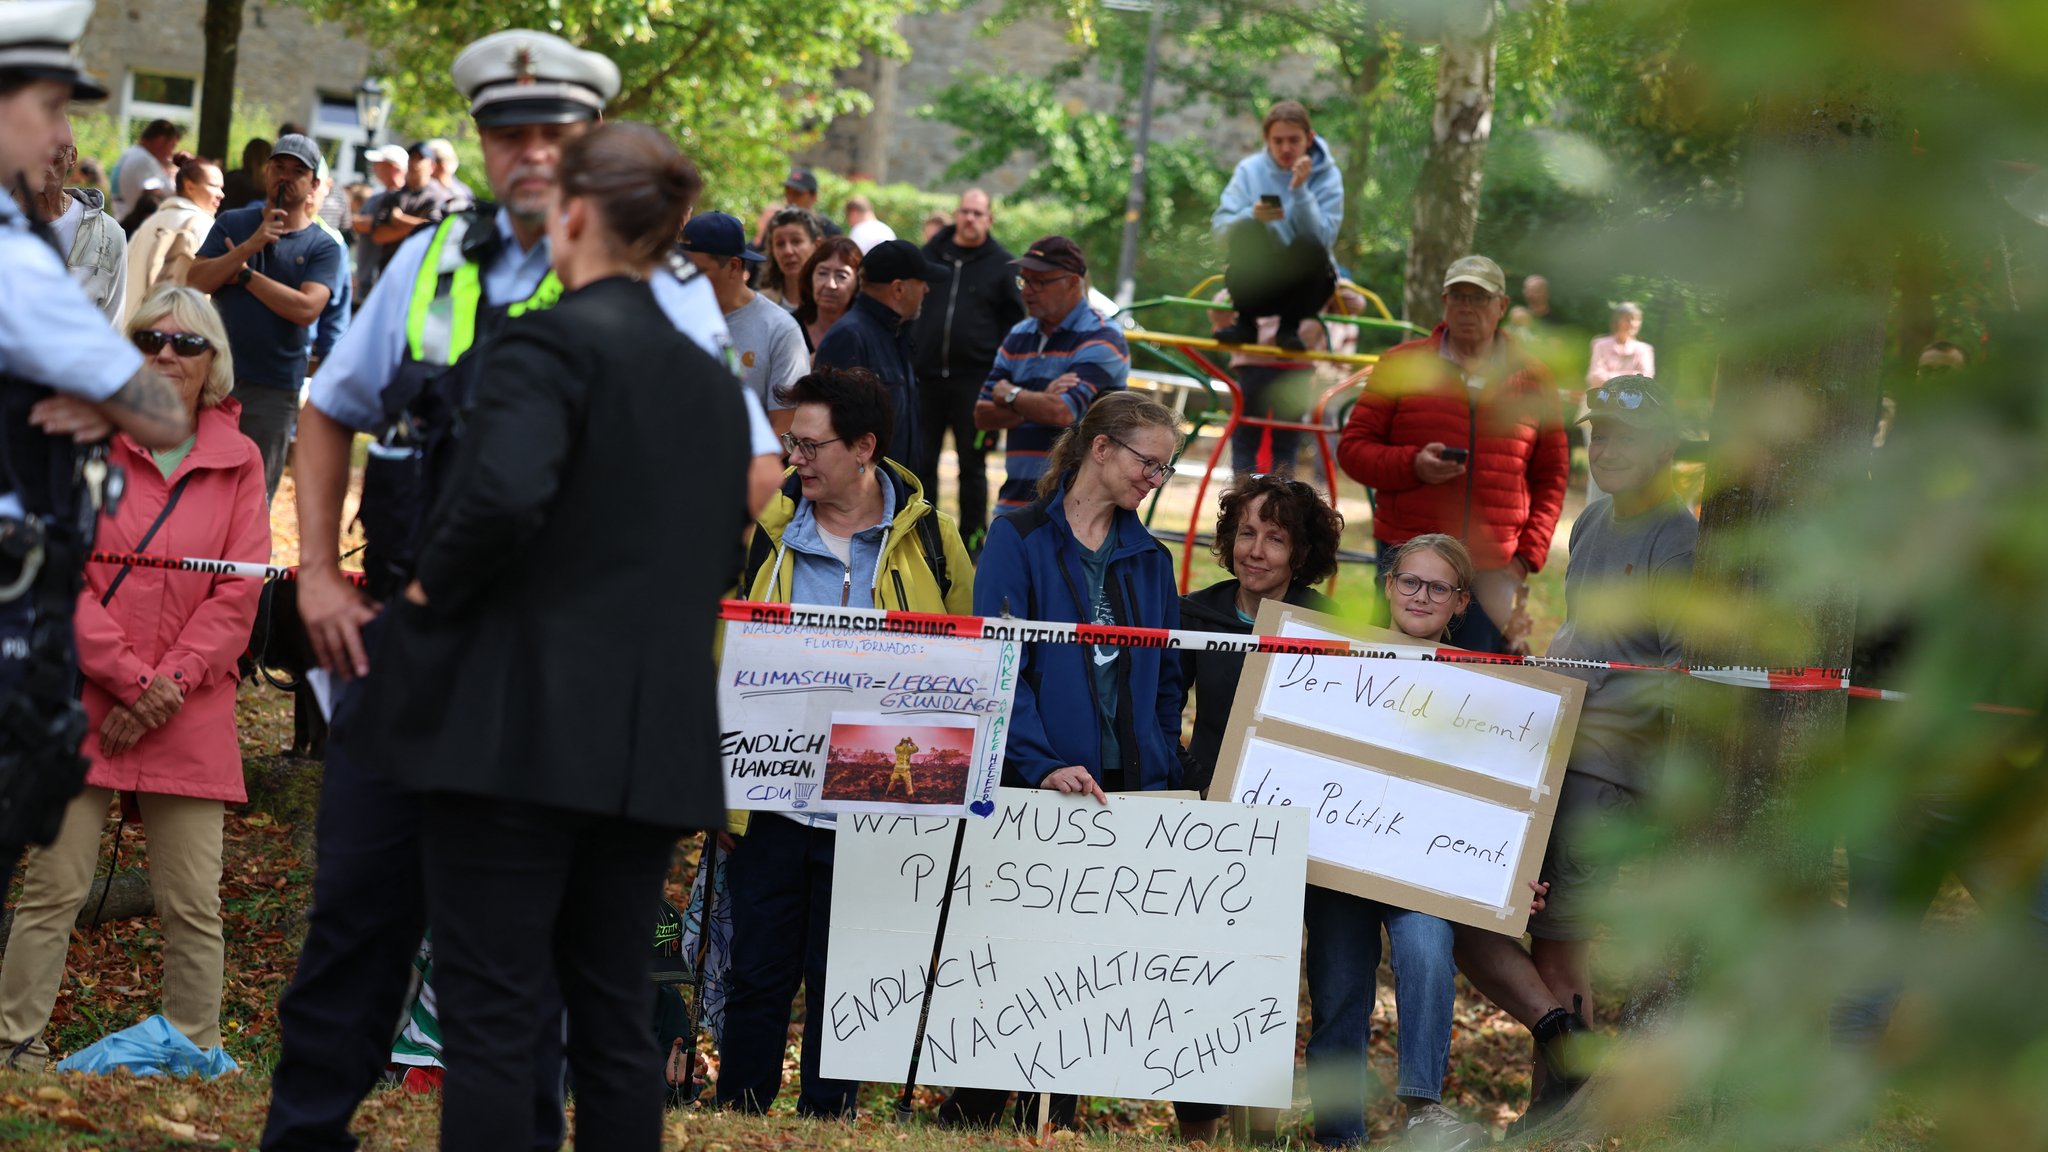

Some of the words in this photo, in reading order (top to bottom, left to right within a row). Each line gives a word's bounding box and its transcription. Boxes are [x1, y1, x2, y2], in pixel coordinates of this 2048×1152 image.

[879, 693, 999, 713] GRUNDLAGE
[1001, 642, 1015, 691] ANKE
[1279, 654, 1342, 693] Der
[1355, 664, 1433, 718] Wald
[1453, 694, 1540, 752] brennt,
[730, 758, 815, 778] HANDELN,
[983, 754, 998, 801] HELFER
[993, 802, 1117, 847] MUSS
[1145, 814, 1280, 856] NOCH
[1242, 768, 1292, 806] die
[1425, 834, 1507, 868] pennt.
[900, 853, 1252, 925] PASSIEREN?
[830, 943, 997, 1041] ENDLICH
[926, 951, 1235, 1072] NACHHALTIGEN
[1014, 998, 1195, 1089] KLIMA-
[1144, 997, 1287, 1095] SCHUTZ
